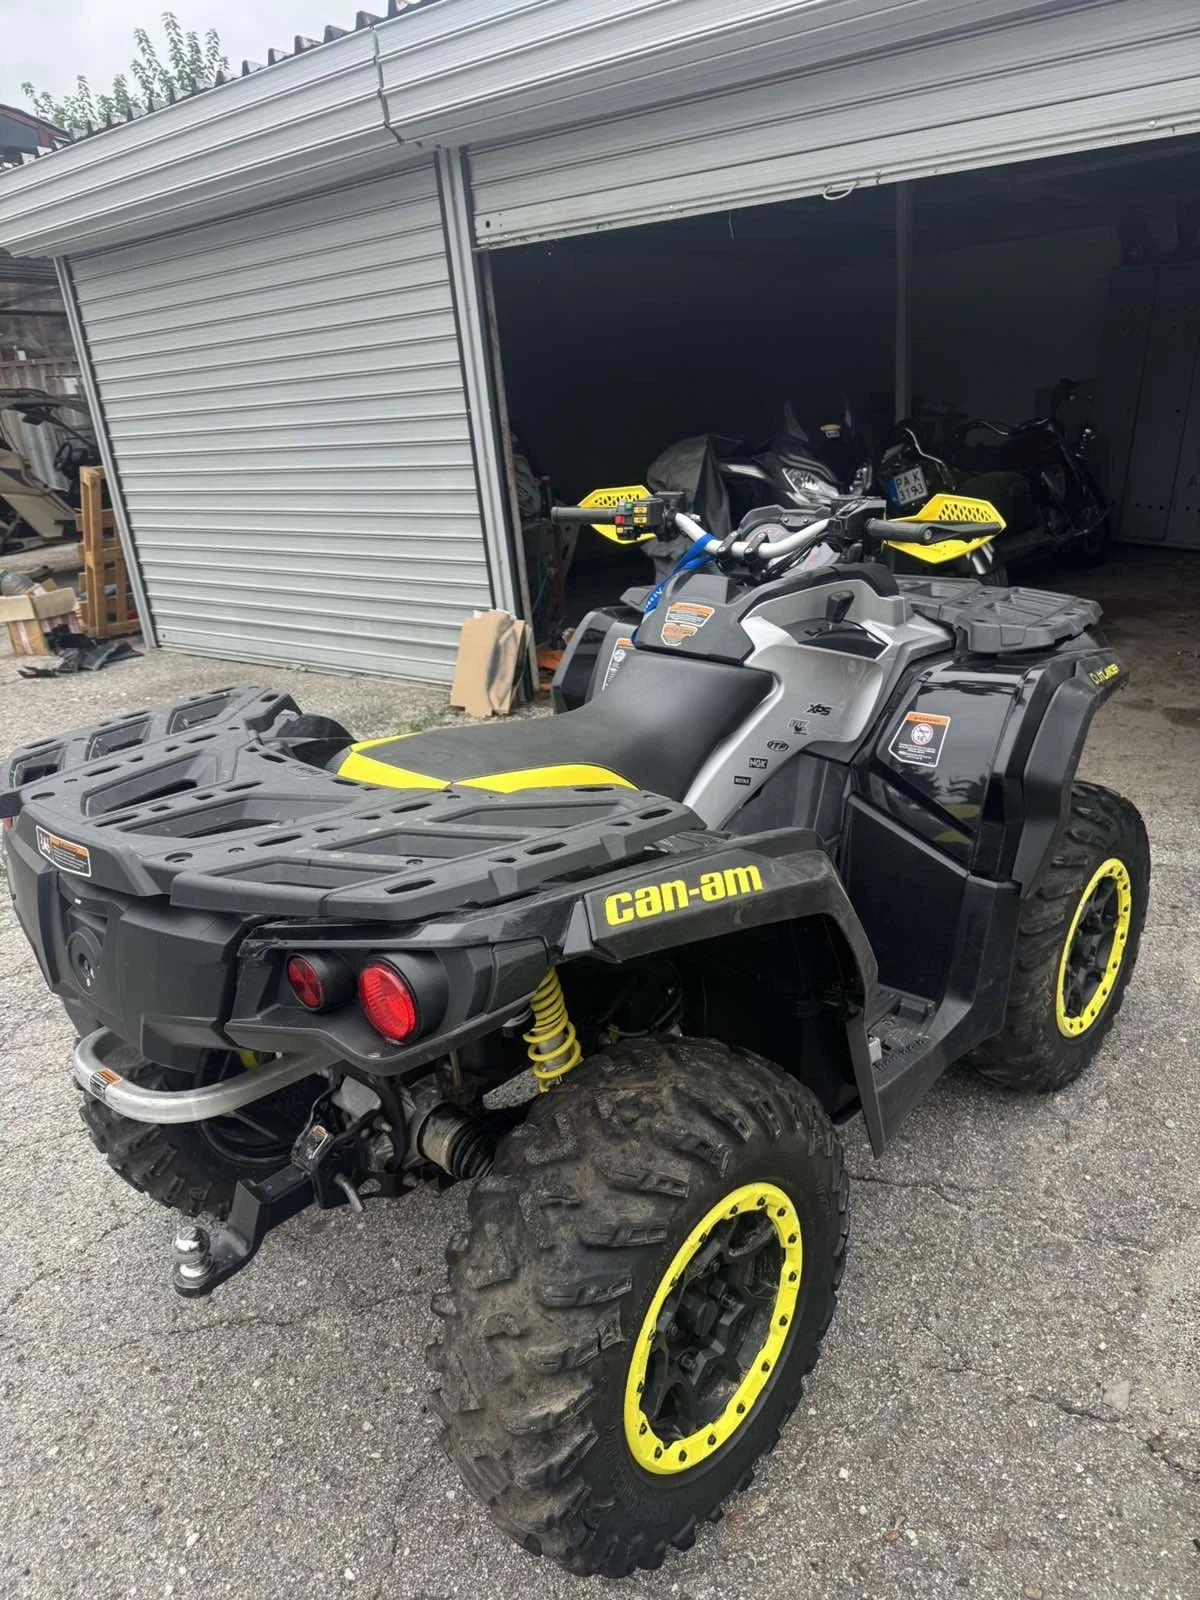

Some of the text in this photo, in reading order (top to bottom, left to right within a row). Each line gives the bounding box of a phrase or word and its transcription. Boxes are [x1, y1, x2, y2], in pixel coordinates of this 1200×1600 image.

[806, 703, 832, 716] XPS
[749, 758, 768, 769] NGK
[604, 864, 764, 926] can-am
